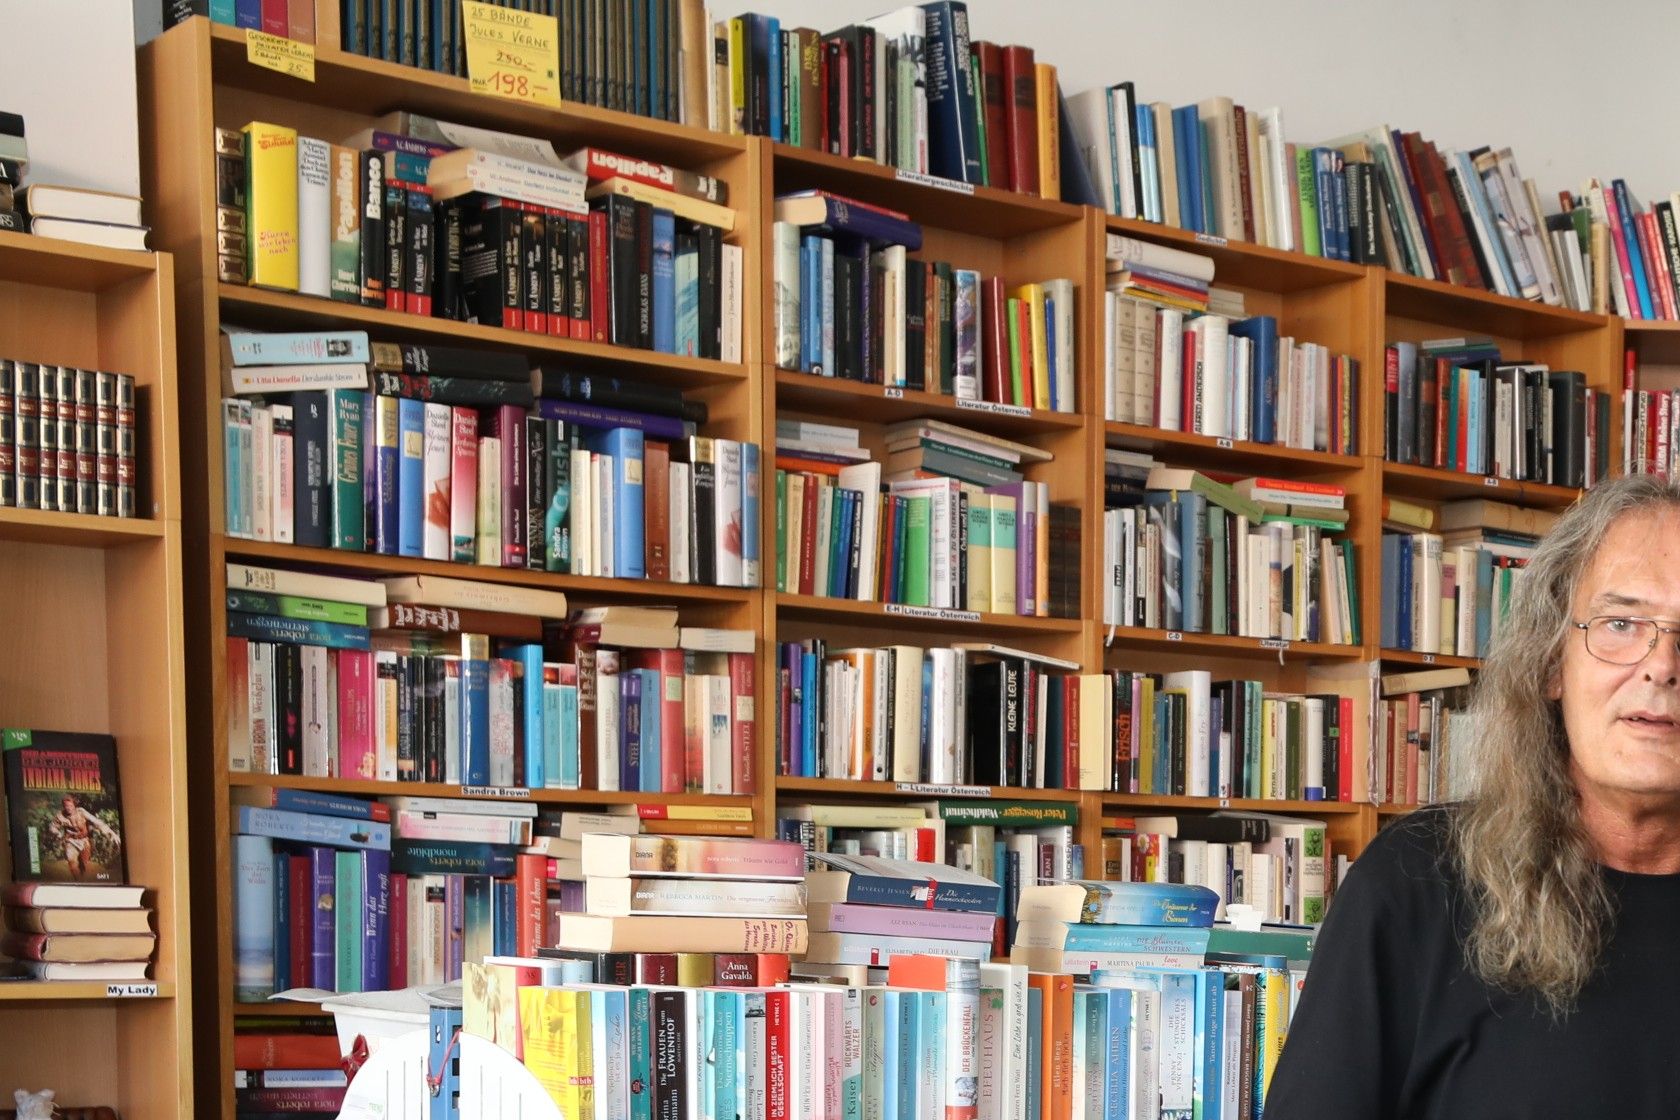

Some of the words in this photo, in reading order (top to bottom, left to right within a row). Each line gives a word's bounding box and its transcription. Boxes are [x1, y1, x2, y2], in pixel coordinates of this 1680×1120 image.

[511, 28, 550, 48] VERNE
[591, 152, 674, 187] Papillon
[365, 156, 383, 220] Banco
[897, 171, 974, 191] Literaturgeschichte
[337, 152, 356, 243] Papillon
[339, 398, 359, 411] Mary
[957, 400, 988, 410] Literatur
[991, 403, 1031, 416] Österreich
[339, 410, 359, 422] Ryan
[552, 526, 562, 560] Sandra
[905, 606, 937, 617] Literatur
[940, 608, 980, 620] Österreich
[1008, 669, 1019, 700] LEUTE
[1007, 701, 1018, 733] KLEINE
[463, 786, 497, 795] Sandra
[499, 788, 530, 797] Brown
[916, 785, 949, 794] Literatur
[951, 786, 990, 797] Österreich
[721, 971, 753, 982] Gavalda
[727, 962, 749, 971] Anna
[107, 986, 123, 994] My
[127, 986, 156, 995] Lady
[962, 1005, 973, 1060] BRÜCKENFALL
[666, 1017, 677, 1080] LÖWENHOF
[983, 1012, 994, 1098] EFEUHAUS
[962, 1060, 971, 1073] DER
[777, 1054, 785, 1118] GESELLSCHAFT
[846, 1078, 857, 1118] Kaiser
[771, 1108, 778, 1118] IN
